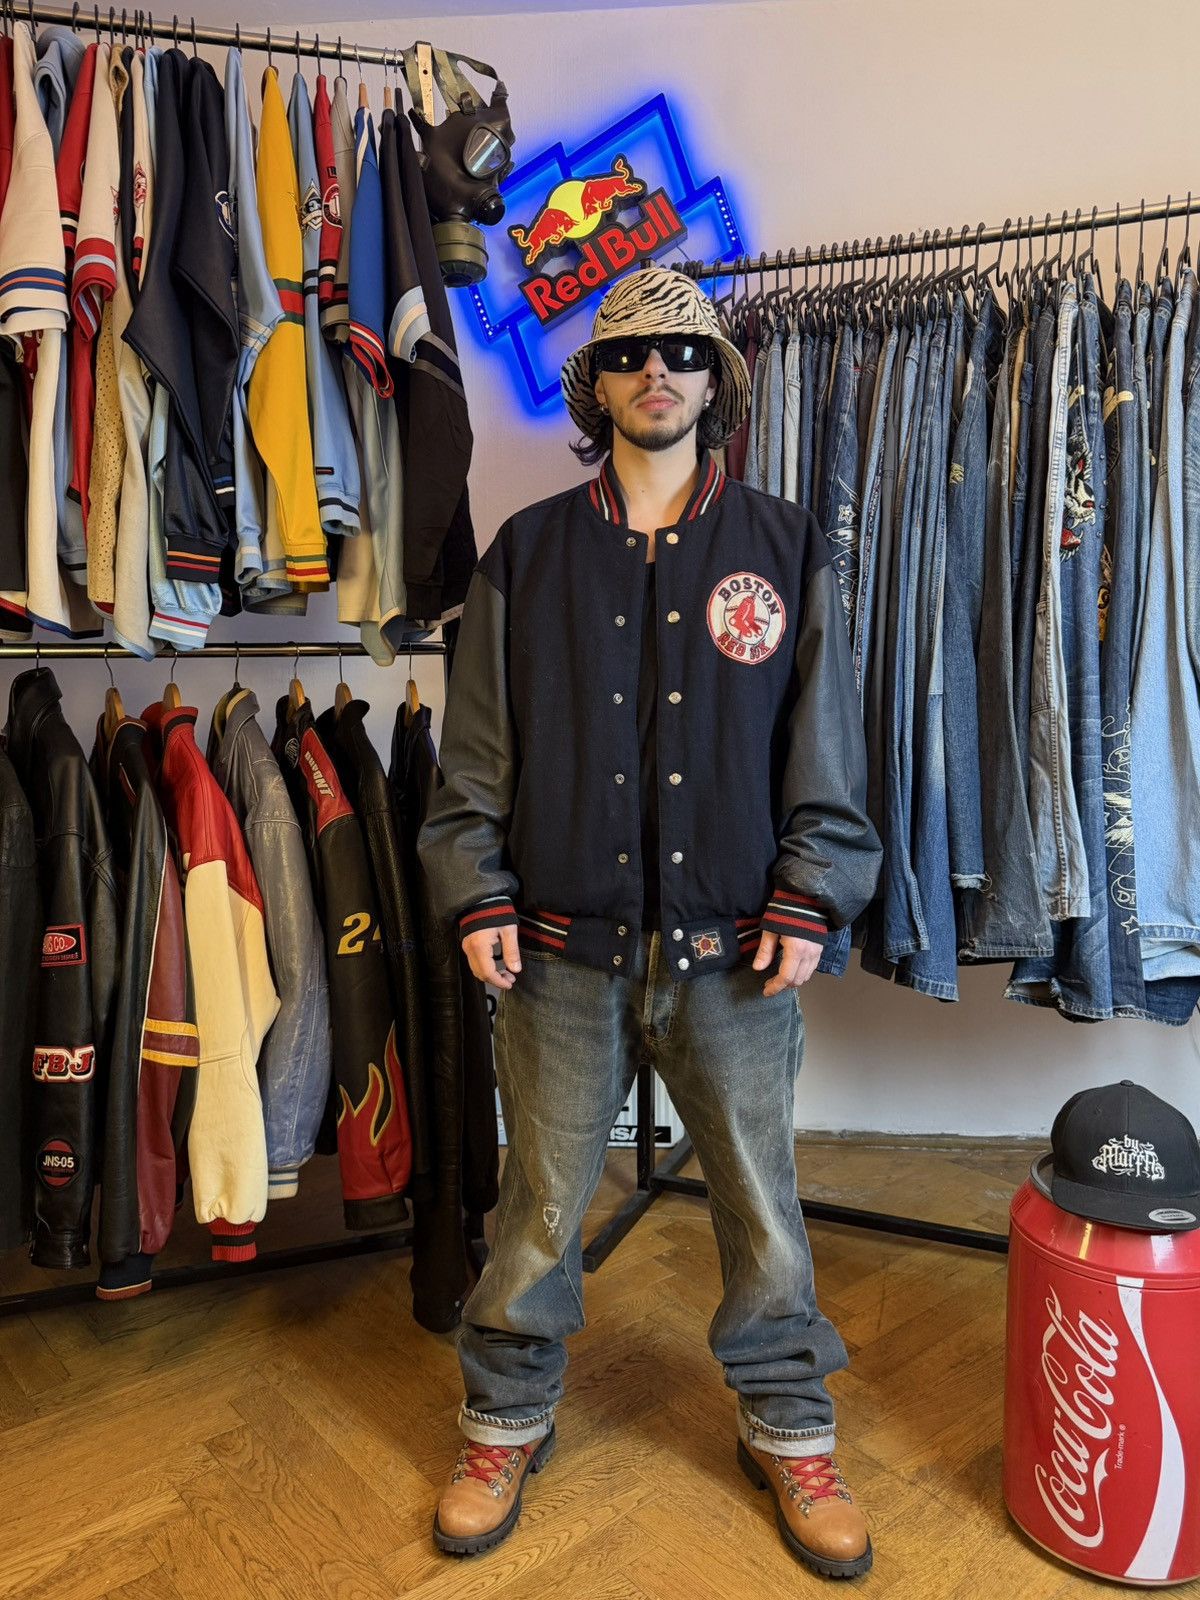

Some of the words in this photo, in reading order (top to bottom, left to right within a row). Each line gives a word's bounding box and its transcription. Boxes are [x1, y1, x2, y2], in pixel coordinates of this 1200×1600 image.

[523, 242, 608, 320] Red
[599, 193, 682, 270] Bull
[718, 577, 781, 615] BOSTON
[717, 632, 746, 657] RED
[33, 1048, 95, 1080] FBJ
[1123, 1134, 1139, 1151] by
[43, 1155, 75, 1168] JNS-05
[1035, 1284, 1119, 1548] Coca-Cola
